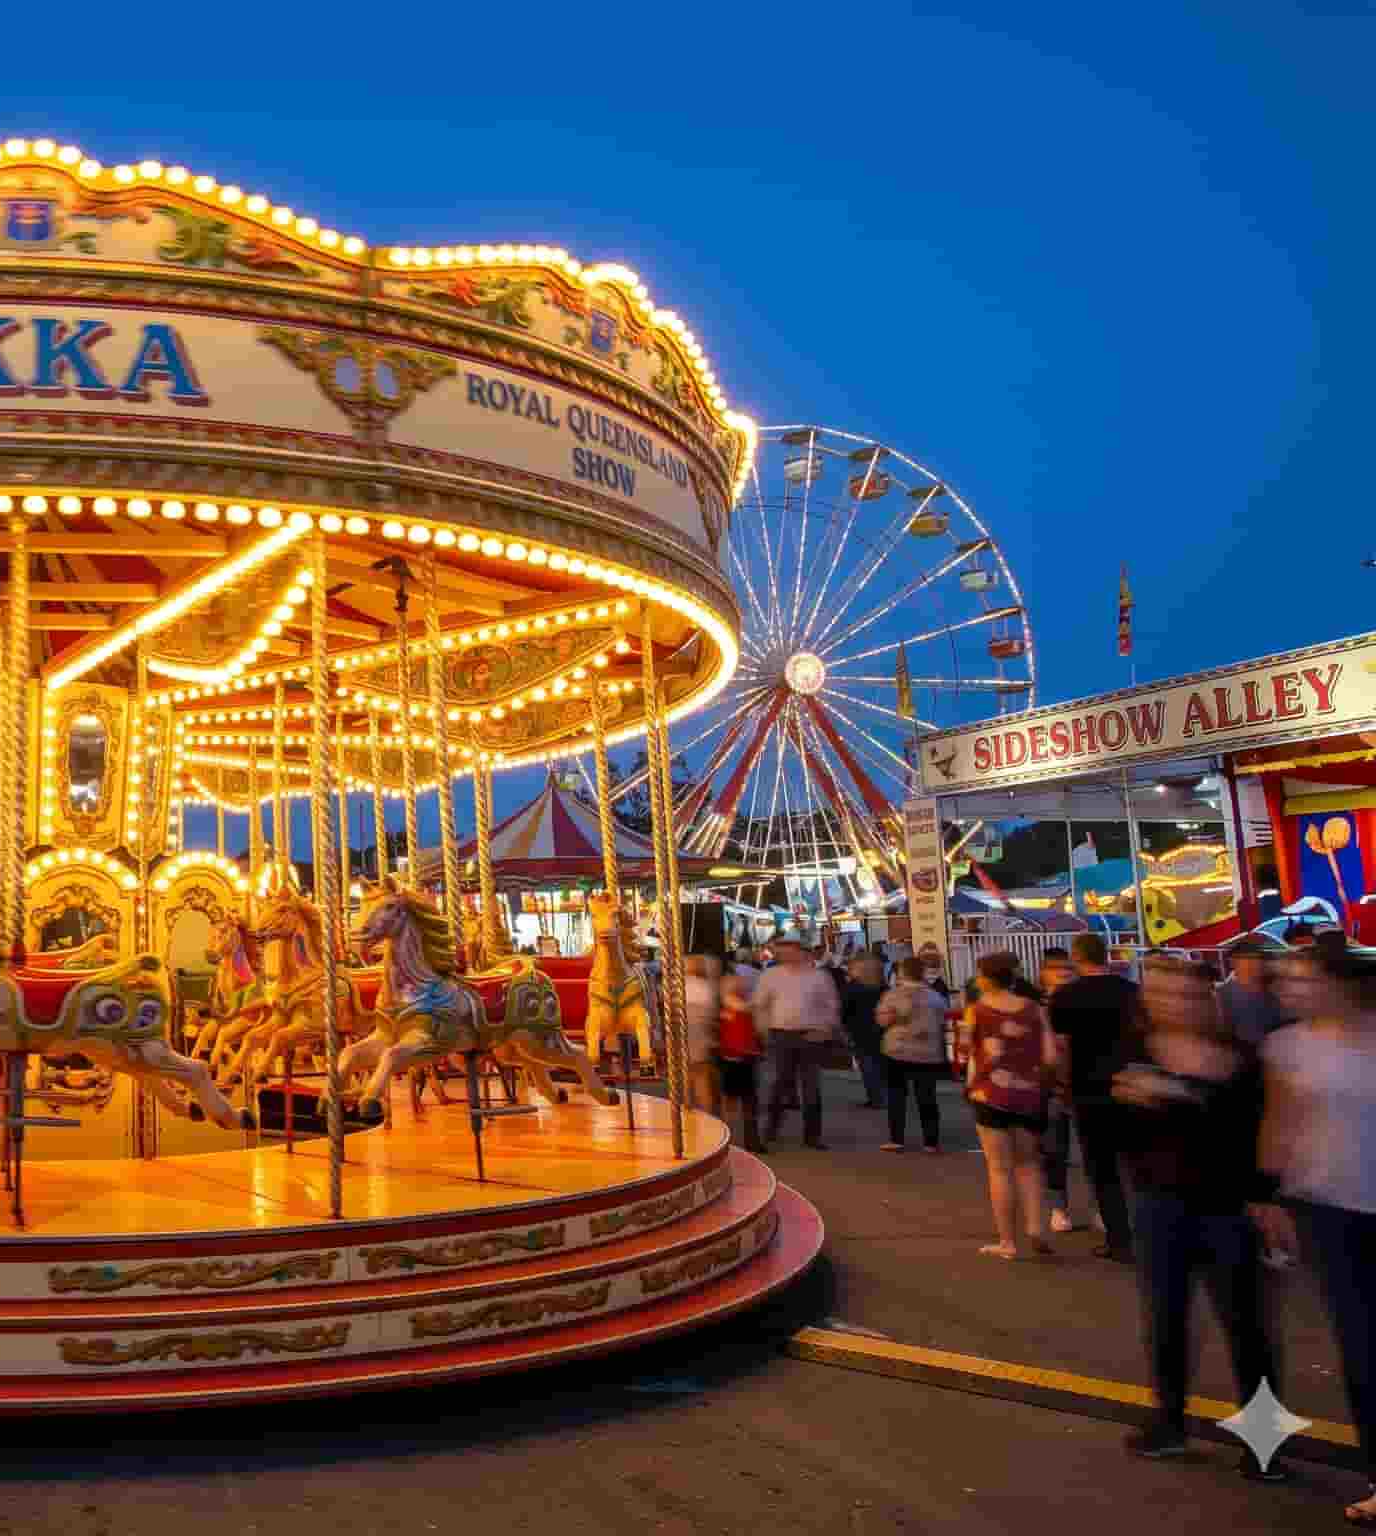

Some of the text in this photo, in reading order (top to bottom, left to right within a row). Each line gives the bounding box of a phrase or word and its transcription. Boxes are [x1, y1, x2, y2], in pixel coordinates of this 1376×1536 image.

[465, 373, 690, 489] ROYAL QUEENSLAND
[573, 447, 637, 497] SHOW
[973, 662, 1345, 772] SIDESHOW ALLEY
